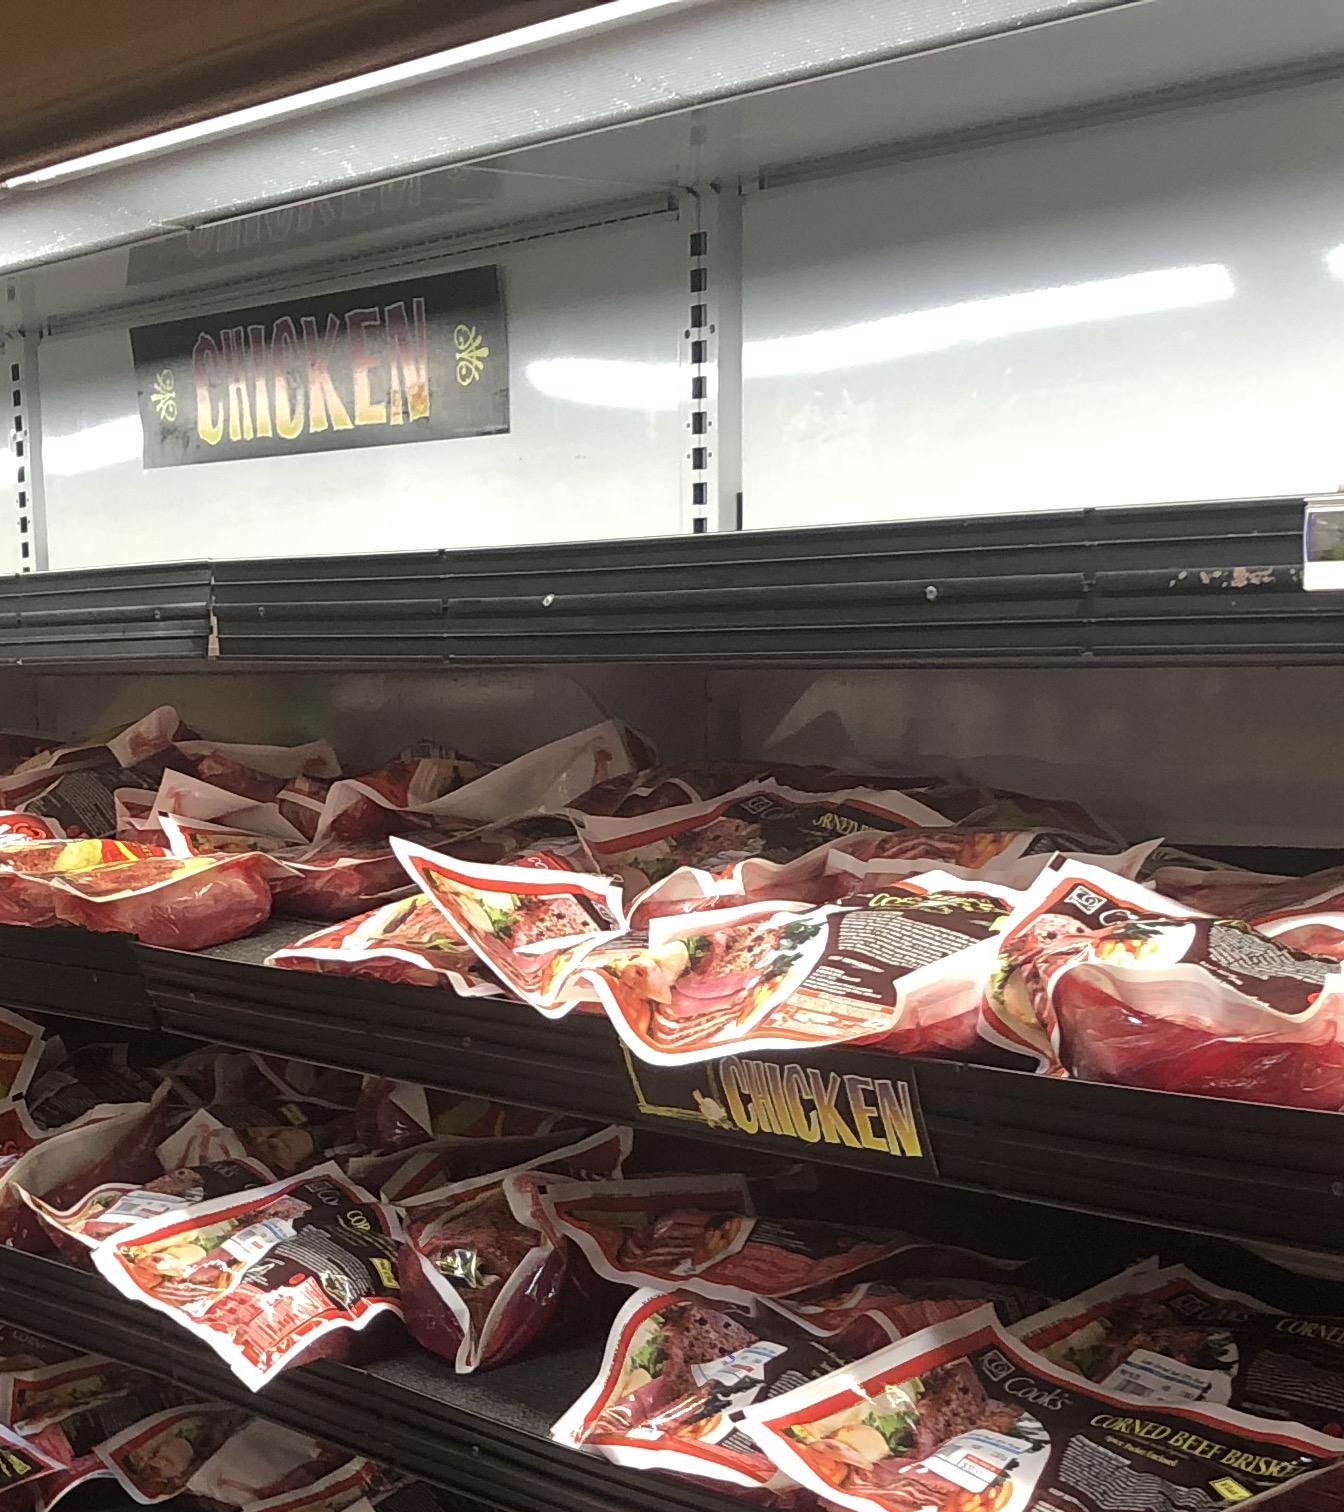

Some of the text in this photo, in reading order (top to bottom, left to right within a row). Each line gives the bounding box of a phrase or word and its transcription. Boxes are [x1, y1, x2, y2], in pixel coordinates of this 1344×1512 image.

[192, 298, 431, 446] CHICKEN
[719, 1056, 924, 1157] CHICKEN
[1003, 1376, 1074, 1412] Cook's
[1089, 1413, 1172, 1442] CORNED
[1168, 1429, 1225, 1460] BEEF
